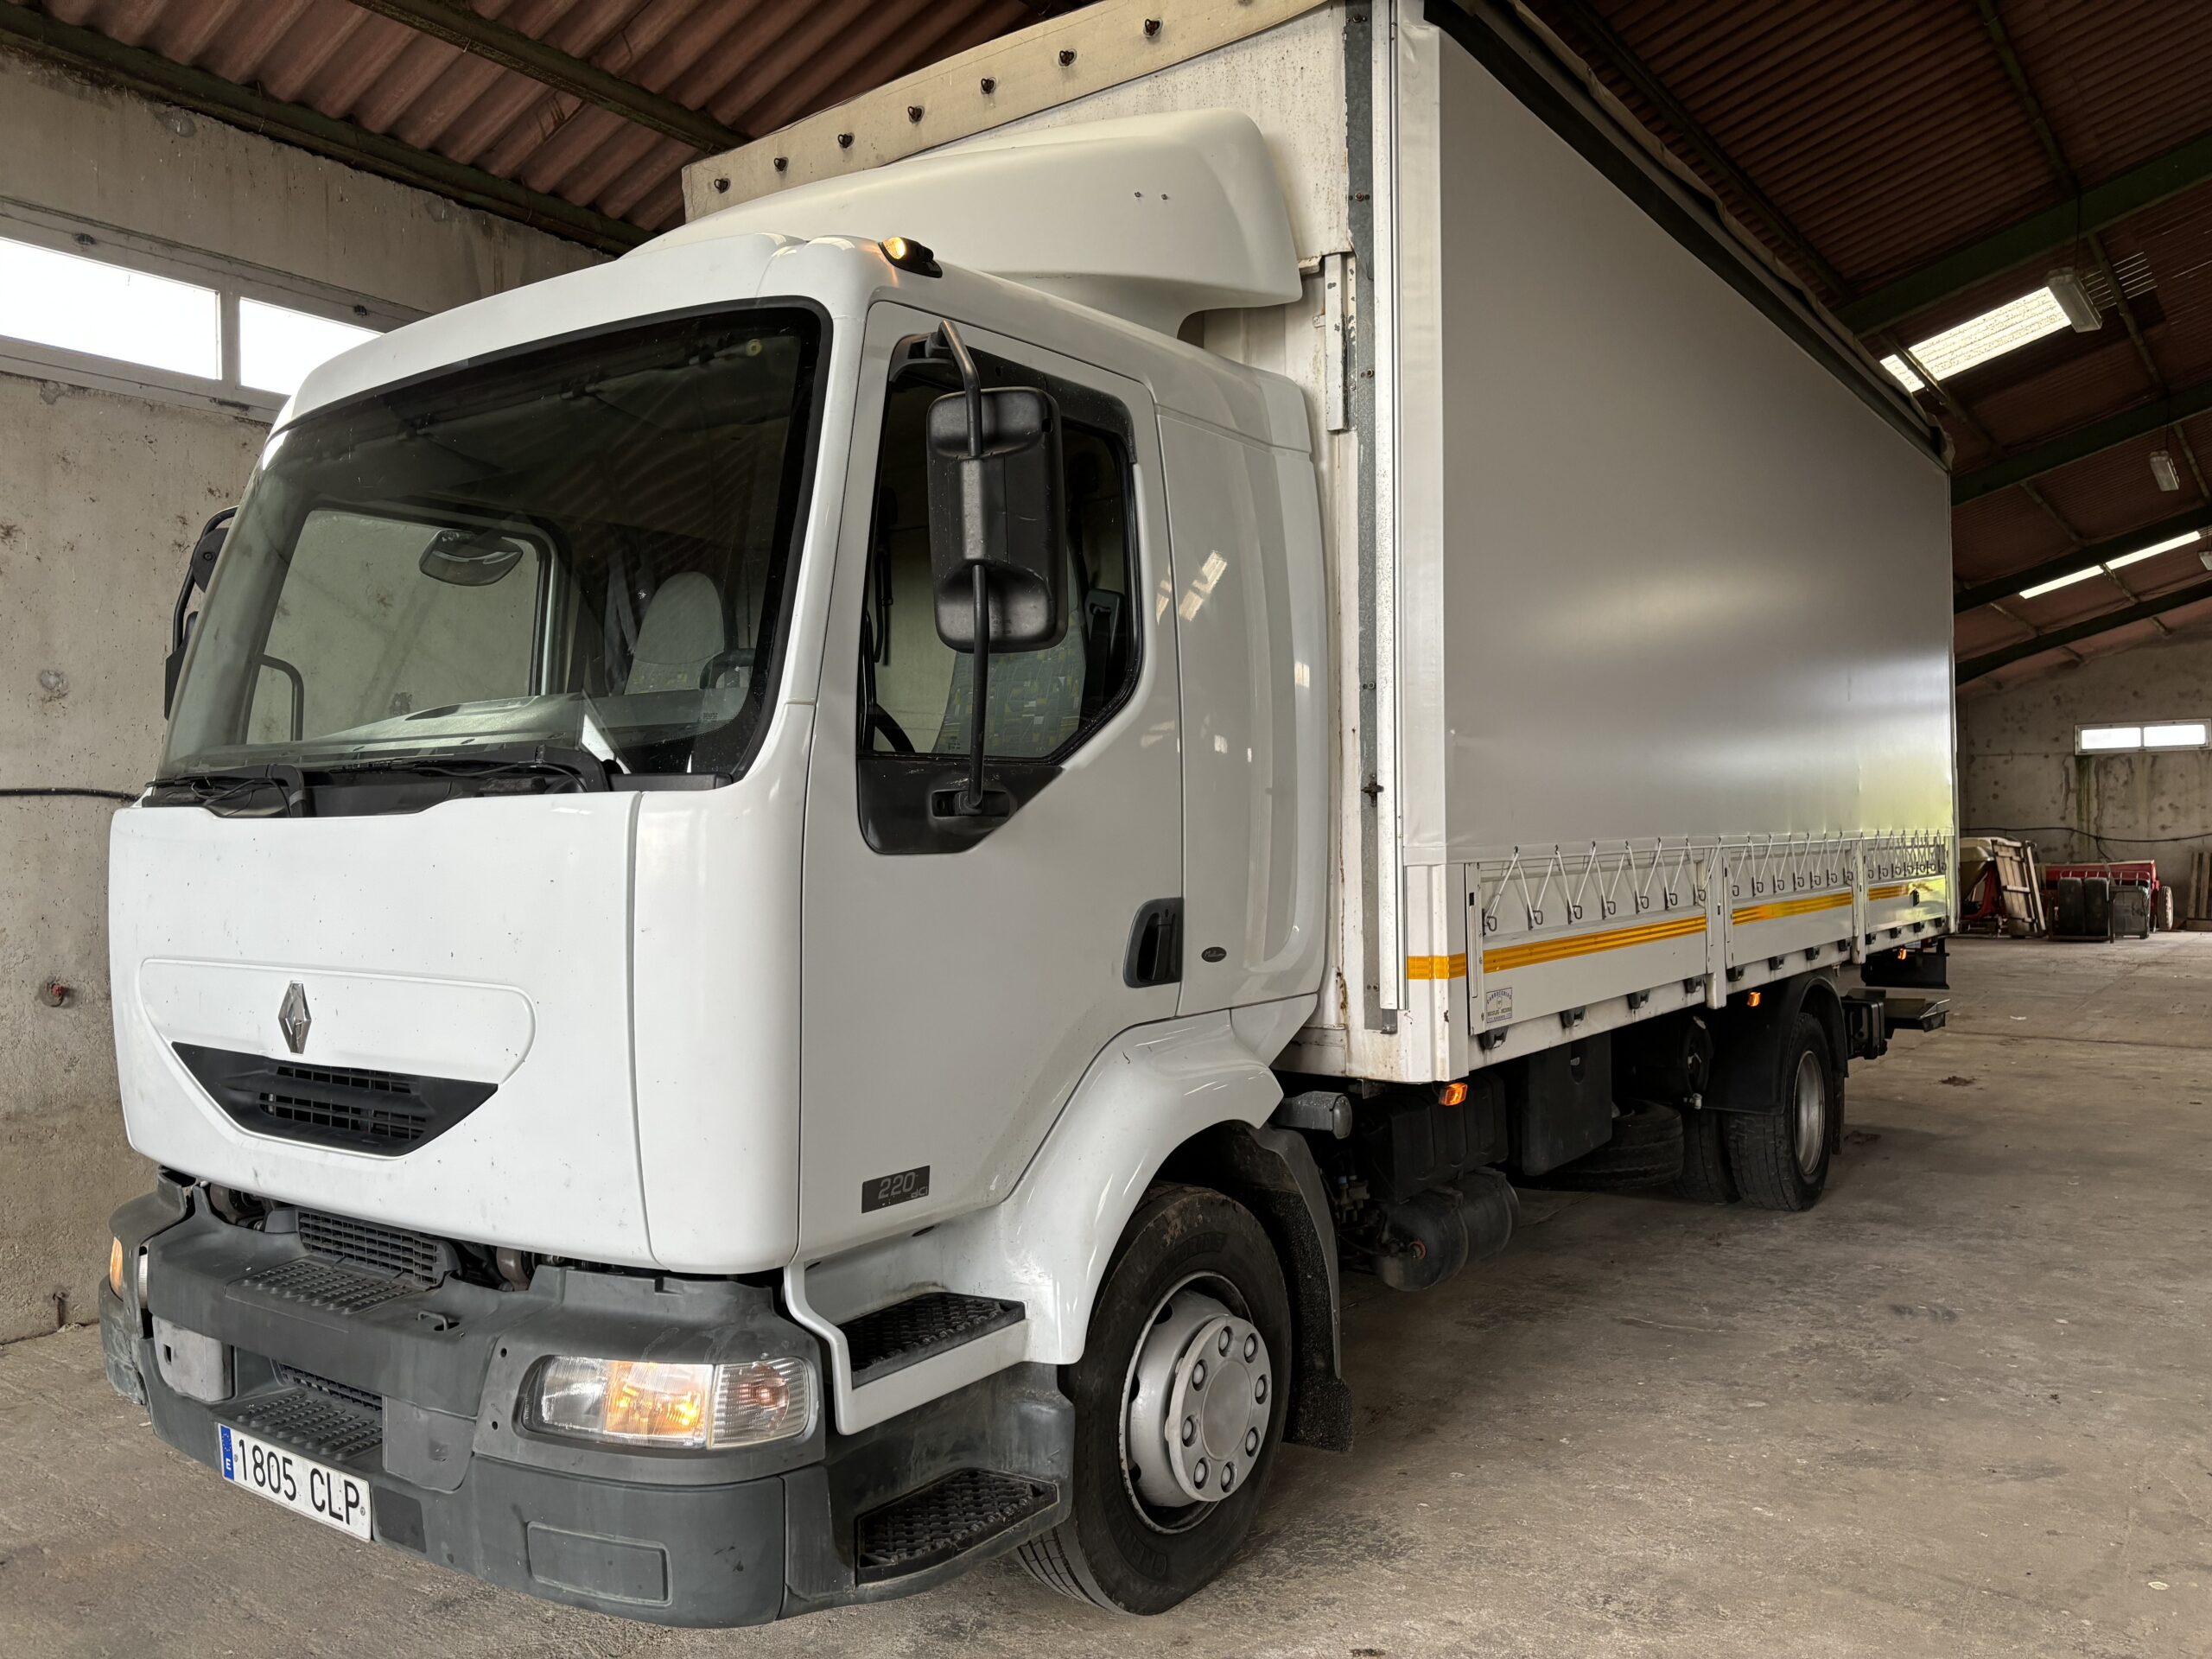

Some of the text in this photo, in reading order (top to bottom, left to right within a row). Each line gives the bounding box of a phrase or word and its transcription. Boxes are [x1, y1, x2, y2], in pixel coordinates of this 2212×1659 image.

[878, 1171, 916, 1200] 220
[226, 1458, 232, 1471] E
[238, 1439, 359, 1526] 1805 CLP
